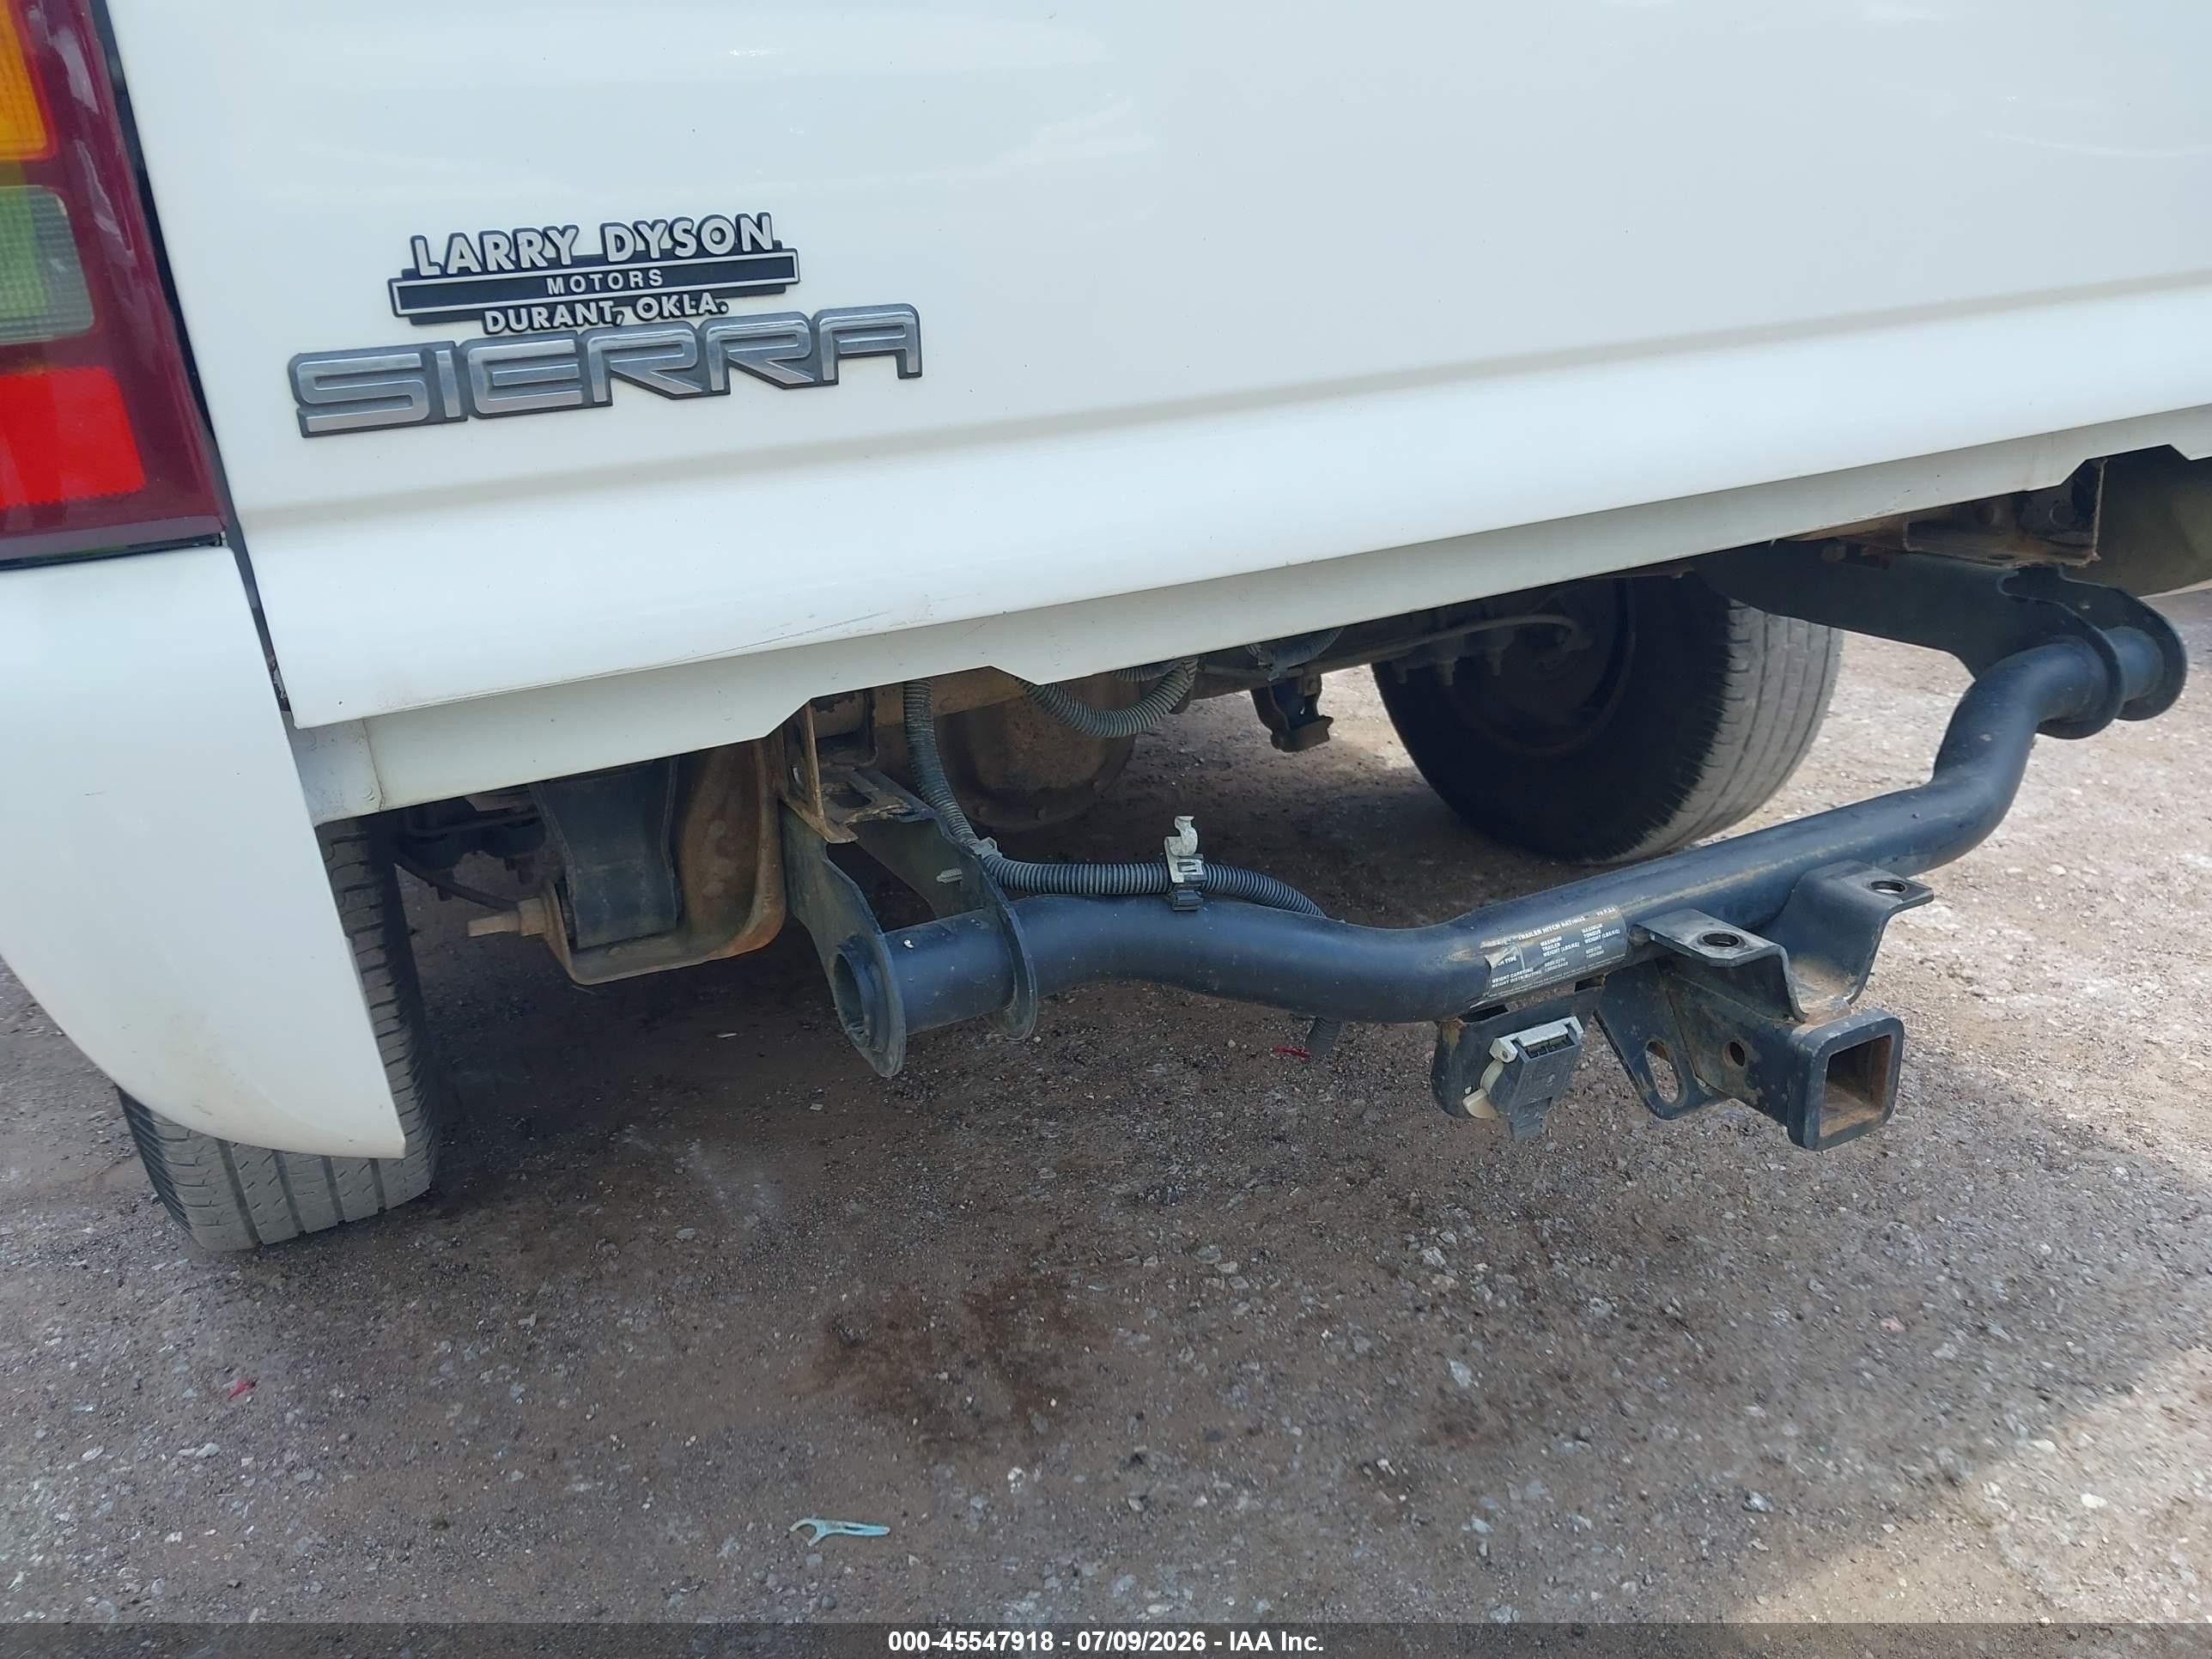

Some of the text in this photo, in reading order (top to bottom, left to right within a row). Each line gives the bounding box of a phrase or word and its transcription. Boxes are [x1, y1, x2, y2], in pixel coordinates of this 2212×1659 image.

[410, 212, 776, 276] LARRY DYSON
[545, 269, 665, 296] MOTORS
[483, 292, 730, 335] DURANT, OKLA.
[288, 303, 922, 438] SIERRA
[1518, 929, 1542, 941] TRAILER
[1542, 923, 1561, 934] HITCH
[1581, 923, 1603, 933] MAXIMUM
[1540, 935, 1563, 946] MAXIMUM
[1541, 942, 1561, 951] TRAILER
